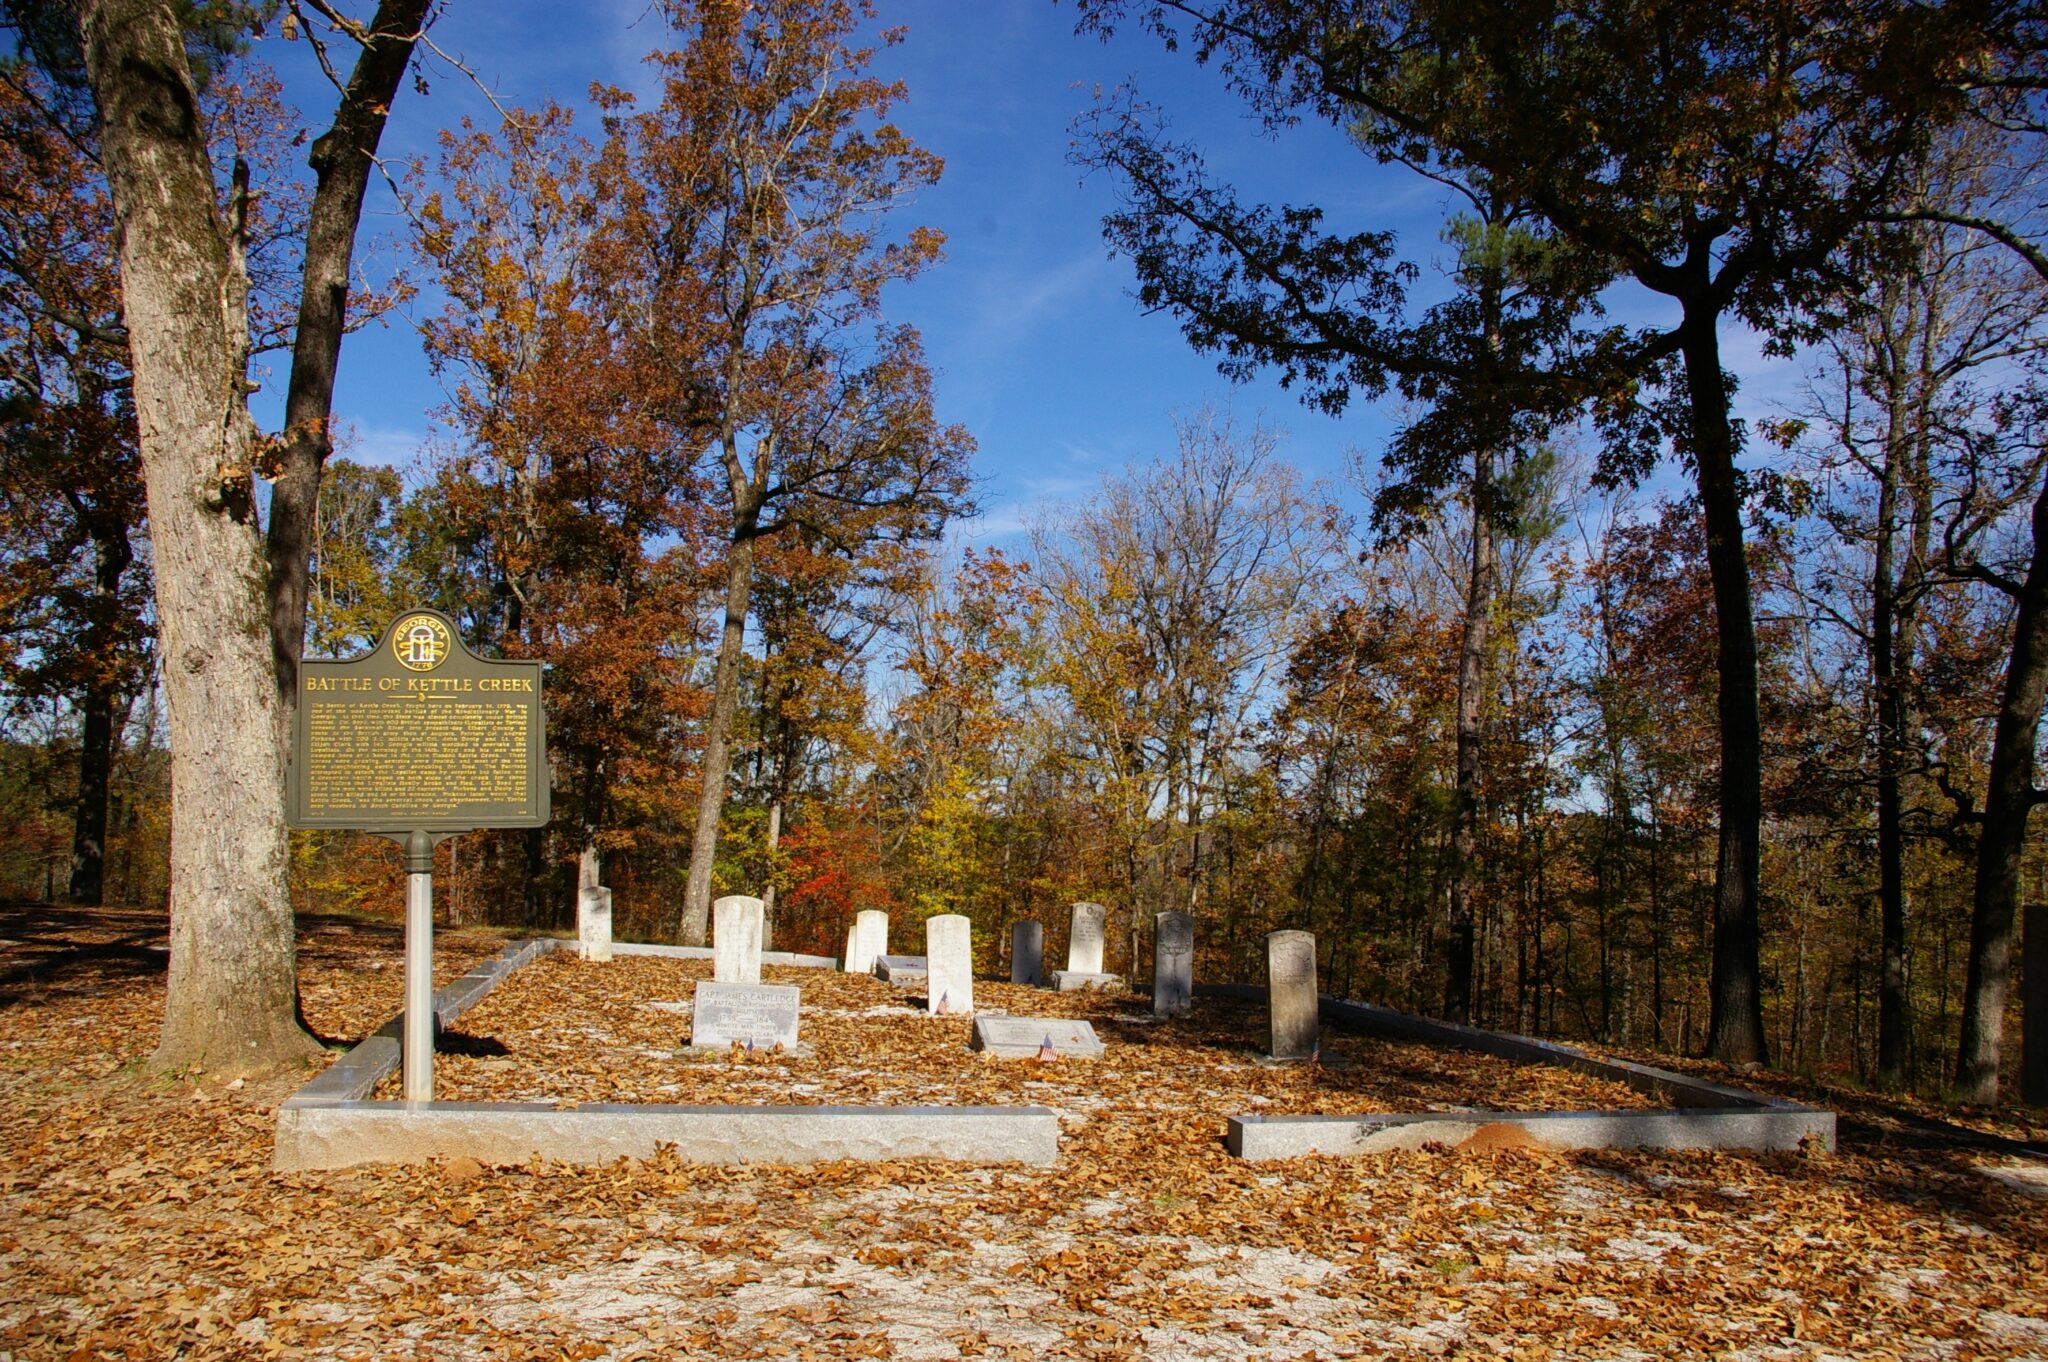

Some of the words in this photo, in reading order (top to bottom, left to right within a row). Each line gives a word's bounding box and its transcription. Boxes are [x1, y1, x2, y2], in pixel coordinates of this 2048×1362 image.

[397, 618, 446, 640] GEORGIA
[306, 678, 372, 691] BATTLE
[378, 678, 400, 691] OF
[408, 678, 472, 692] KETTLE
[479, 678, 533, 692] CREEK
